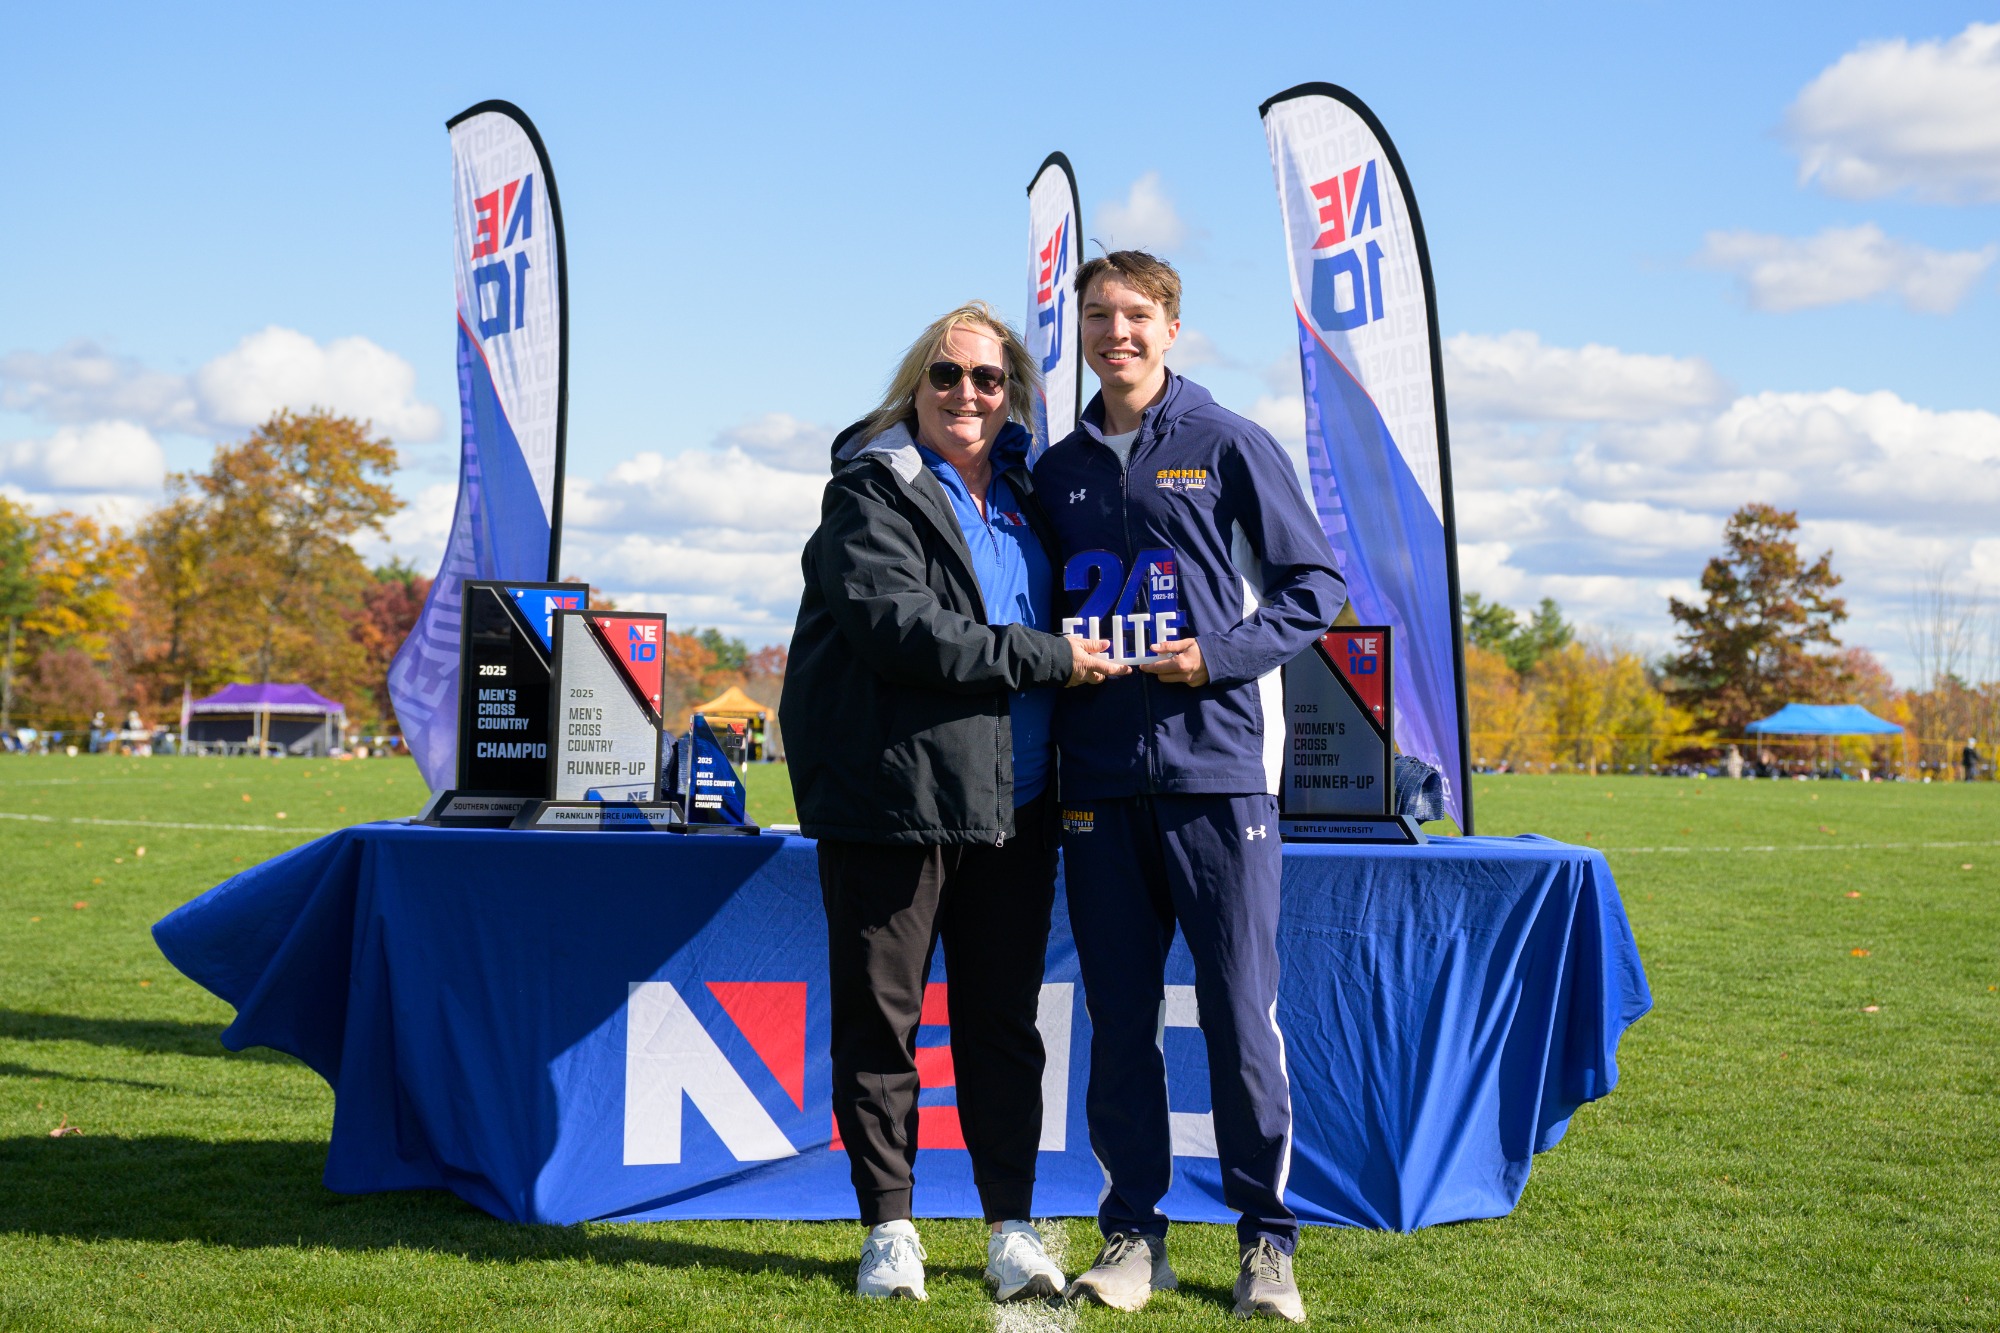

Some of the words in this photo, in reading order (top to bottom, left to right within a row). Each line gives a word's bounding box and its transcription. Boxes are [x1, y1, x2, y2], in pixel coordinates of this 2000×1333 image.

[1156, 469, 1207, 479] SNHU
[1150, 561, 1176, 575] NE
[1150, 574, 1175, 592] 10
[1064, 547, 1187, 650] 24
[628, 624, 658, 642] NE
[1062, 612, 1178, 662] ELITE
[629, 643, 657, 662] 10
[1347, 638, 1378, 655] NE
[479, 665, 507, 676] 2025
[1349, 655, 1377, 675] 10
[478, 688, 517, 702] MEN'S
[570, 688, 594, 698] 2025
[478, 702, 516, 716] CROSS
[569, 707, 603, 721] MEN'S
[1294, 704, 1318, 713] 2025
[477, 717, 529, 731] COUNTRY
[568, 723, 602, 737] CROSS
[1293, 722, 1346, 736] WOMEN'S
[476, 742, 547, 759] CHAMPIO
[567, 739, 613, 753] COUNTRY
[1293, 738, 1327, 751] CROSS
[697, 756, 713, 764] 2025
[1293, 753, 1340, 767] COUNTRY
[567, 760, 646, 776] RUNNER-UP
[696, 779, 713, 787] CROSS
[713, 780, 736, 788] COUNTRY
[1293, 774, 1375, 789] RUNNER-UP
[453, 802, 490, 811] SOUTHERN
[490, 803, 523, 812] CONNECT
[695, 801, 722, 809] CHAMPION
[555, 812, 593, 820] FRANKLIN
[594, 812, 621, 820] PIERCE
[621, 812, 665, 820] UNIVERSITY
[1293, 825, 1327, 834] BENTLEY
[1328, 826, 1374, 834] UNIVERSITY
